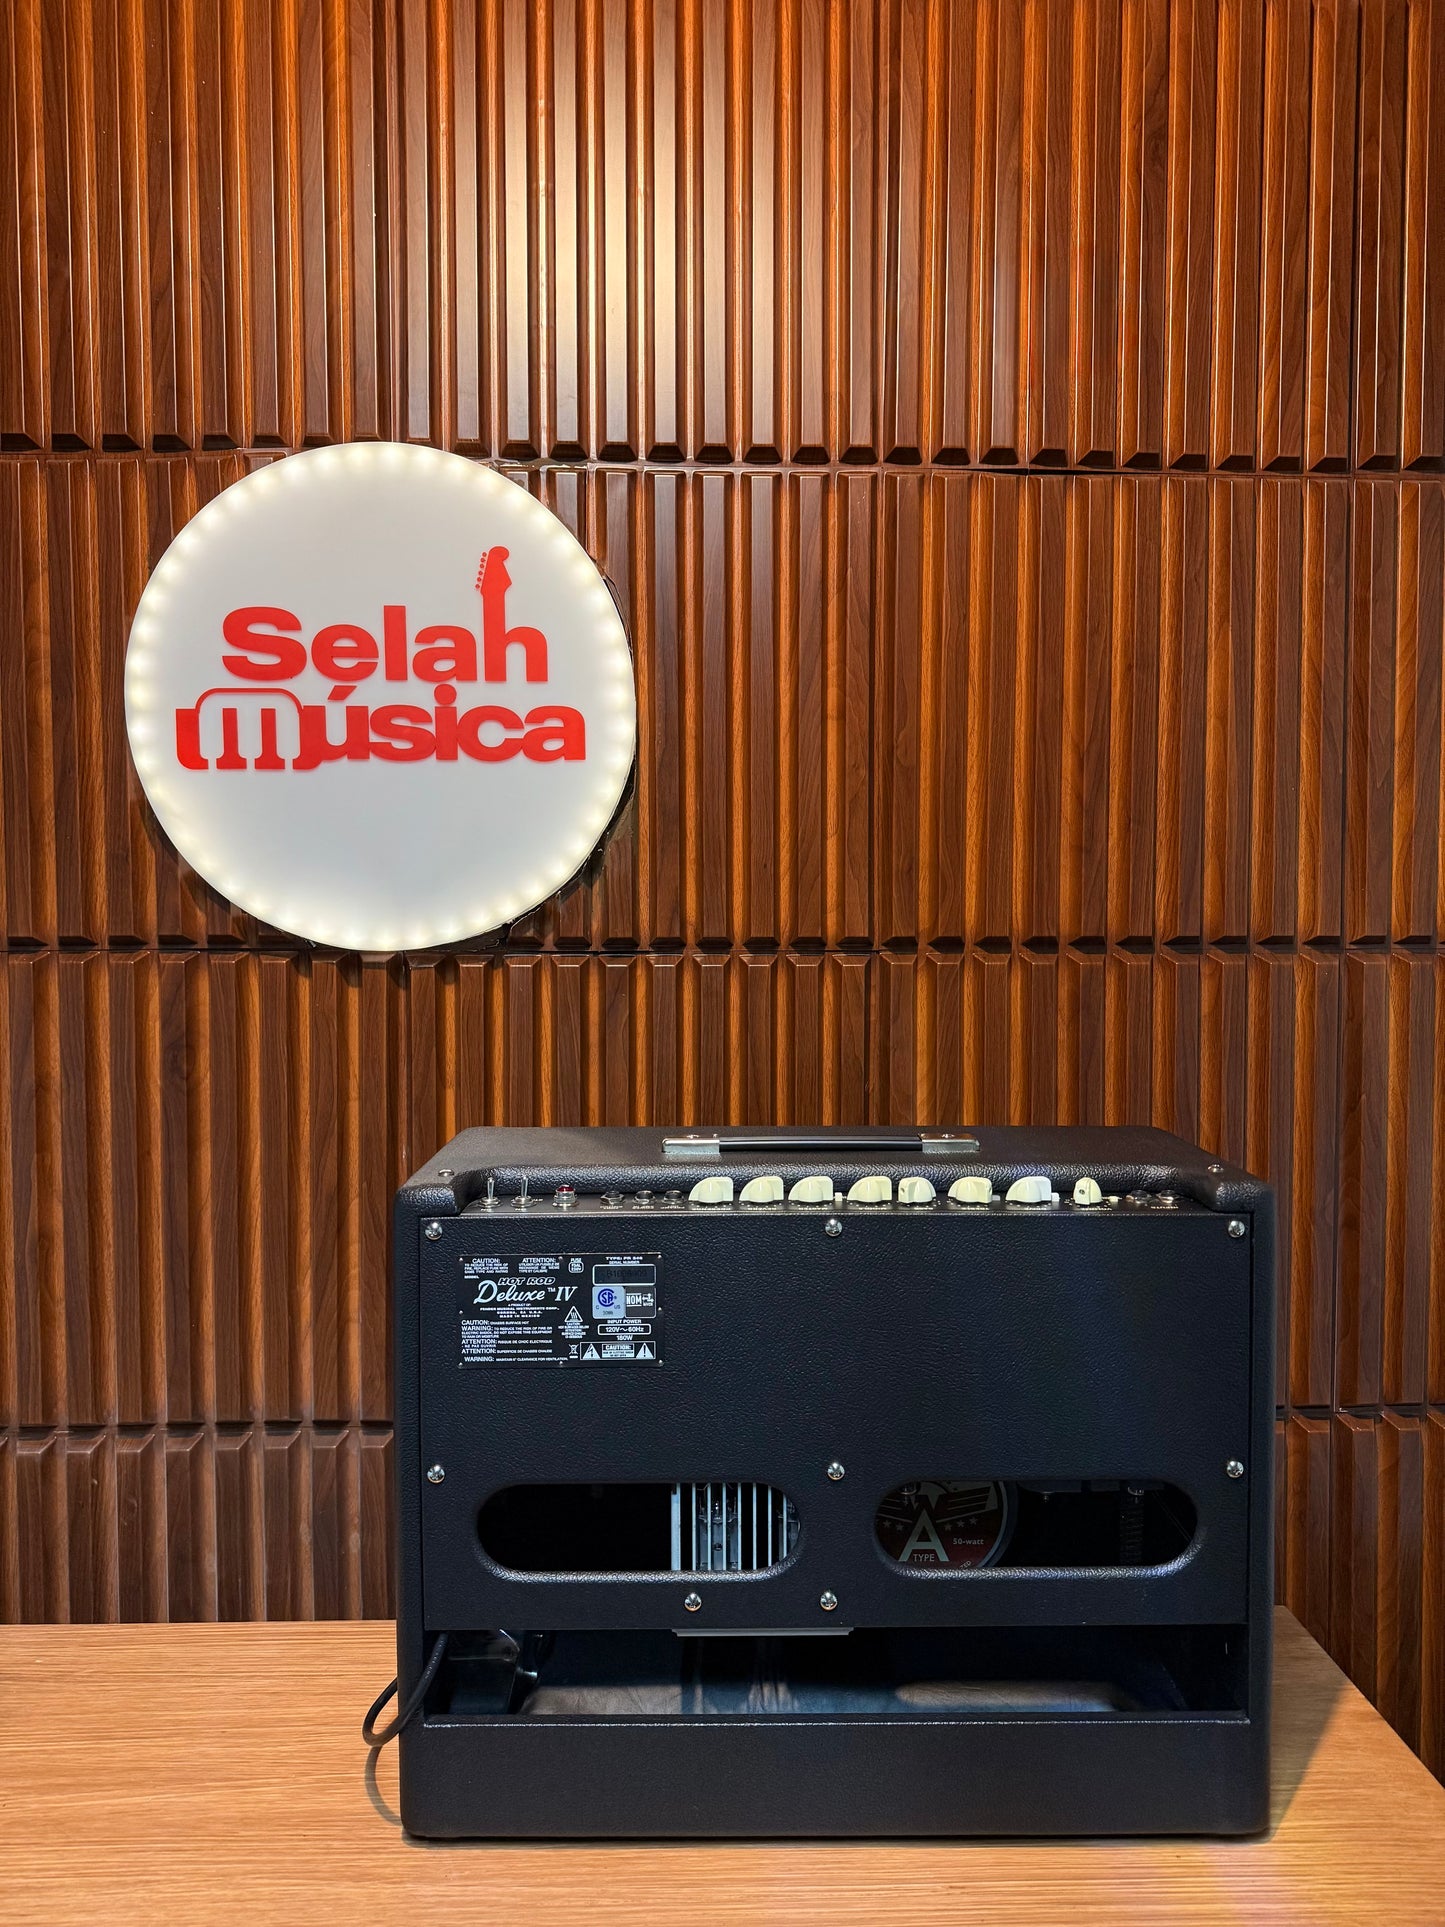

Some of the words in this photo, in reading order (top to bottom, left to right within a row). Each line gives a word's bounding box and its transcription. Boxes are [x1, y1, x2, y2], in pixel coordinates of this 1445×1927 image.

[222, 545, 548, 683] Selah
[498, 1277, 526, 1286] HOT
[526, 1277, 556, 1286] ROD
[473, 1280, 546, 1304] Deluxe
[555, 1286, 578, 1301] IV
[899, 1508, 950, 1562] A
[952, 1537, 985, 1546] 50-watt
[912, 1553, 935, 1562] TYPE
